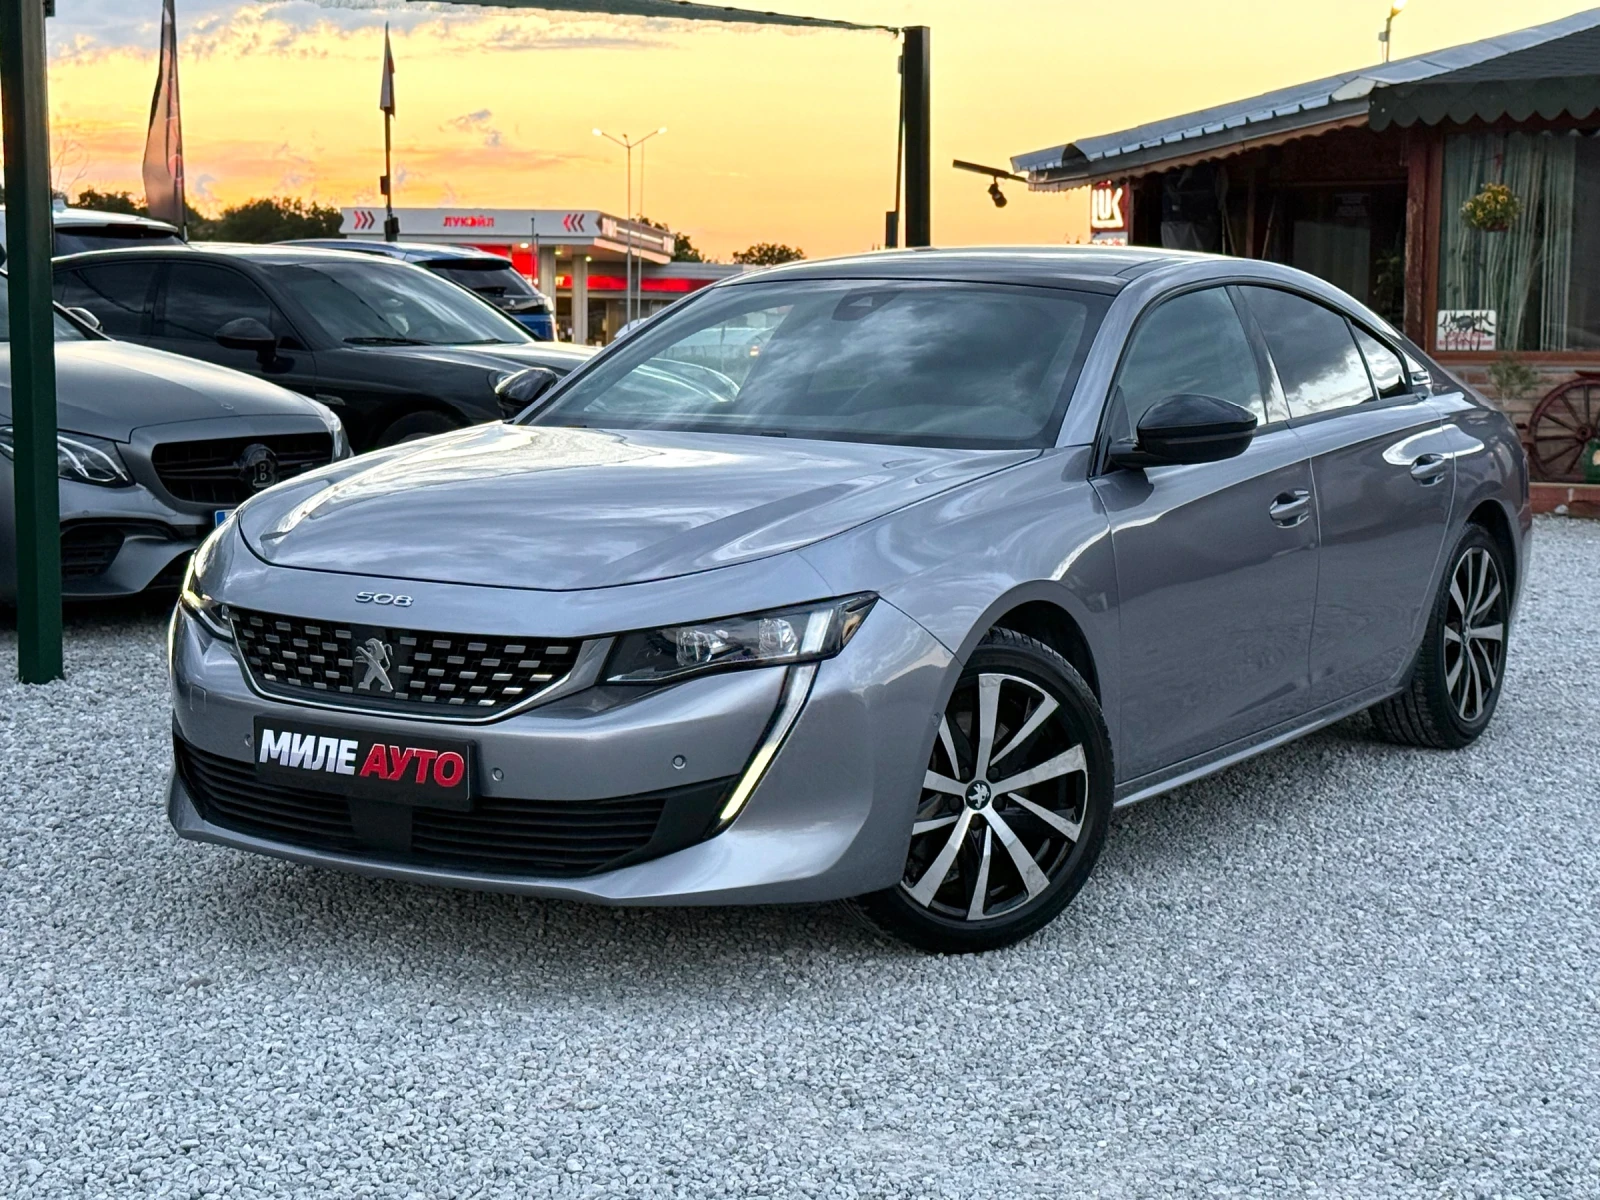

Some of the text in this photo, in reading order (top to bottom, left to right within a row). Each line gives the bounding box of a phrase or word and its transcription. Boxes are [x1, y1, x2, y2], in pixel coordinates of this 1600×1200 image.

[443, 214, 495, 227] ЛУКОЙЛ
[355, 591, 414, 607] 508
[259, 728, 466, 788] МИЛЕ АУТО
